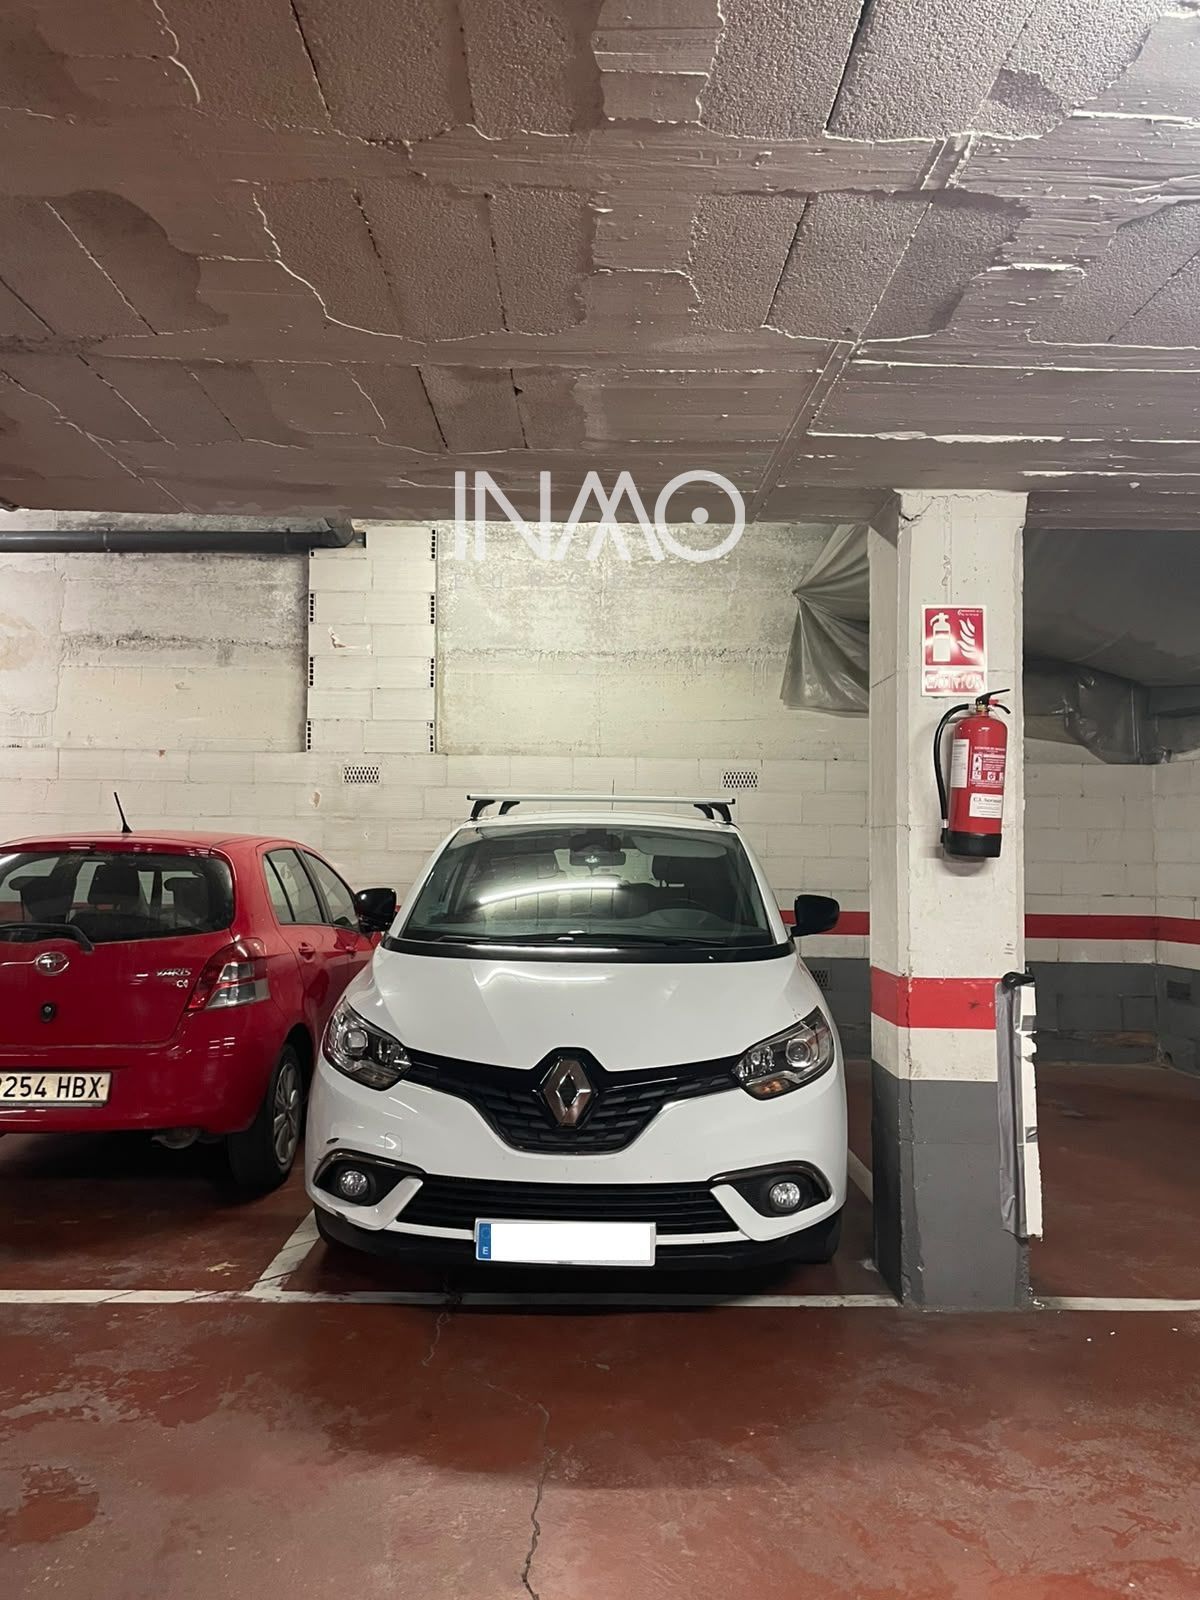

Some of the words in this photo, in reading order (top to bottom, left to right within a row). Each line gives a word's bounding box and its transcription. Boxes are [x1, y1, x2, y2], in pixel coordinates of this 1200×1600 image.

[0, 1075, 47, 1098] 254
[56, 1076, 102, 1099] HBX
[482, 1246, 489, 1255] E
